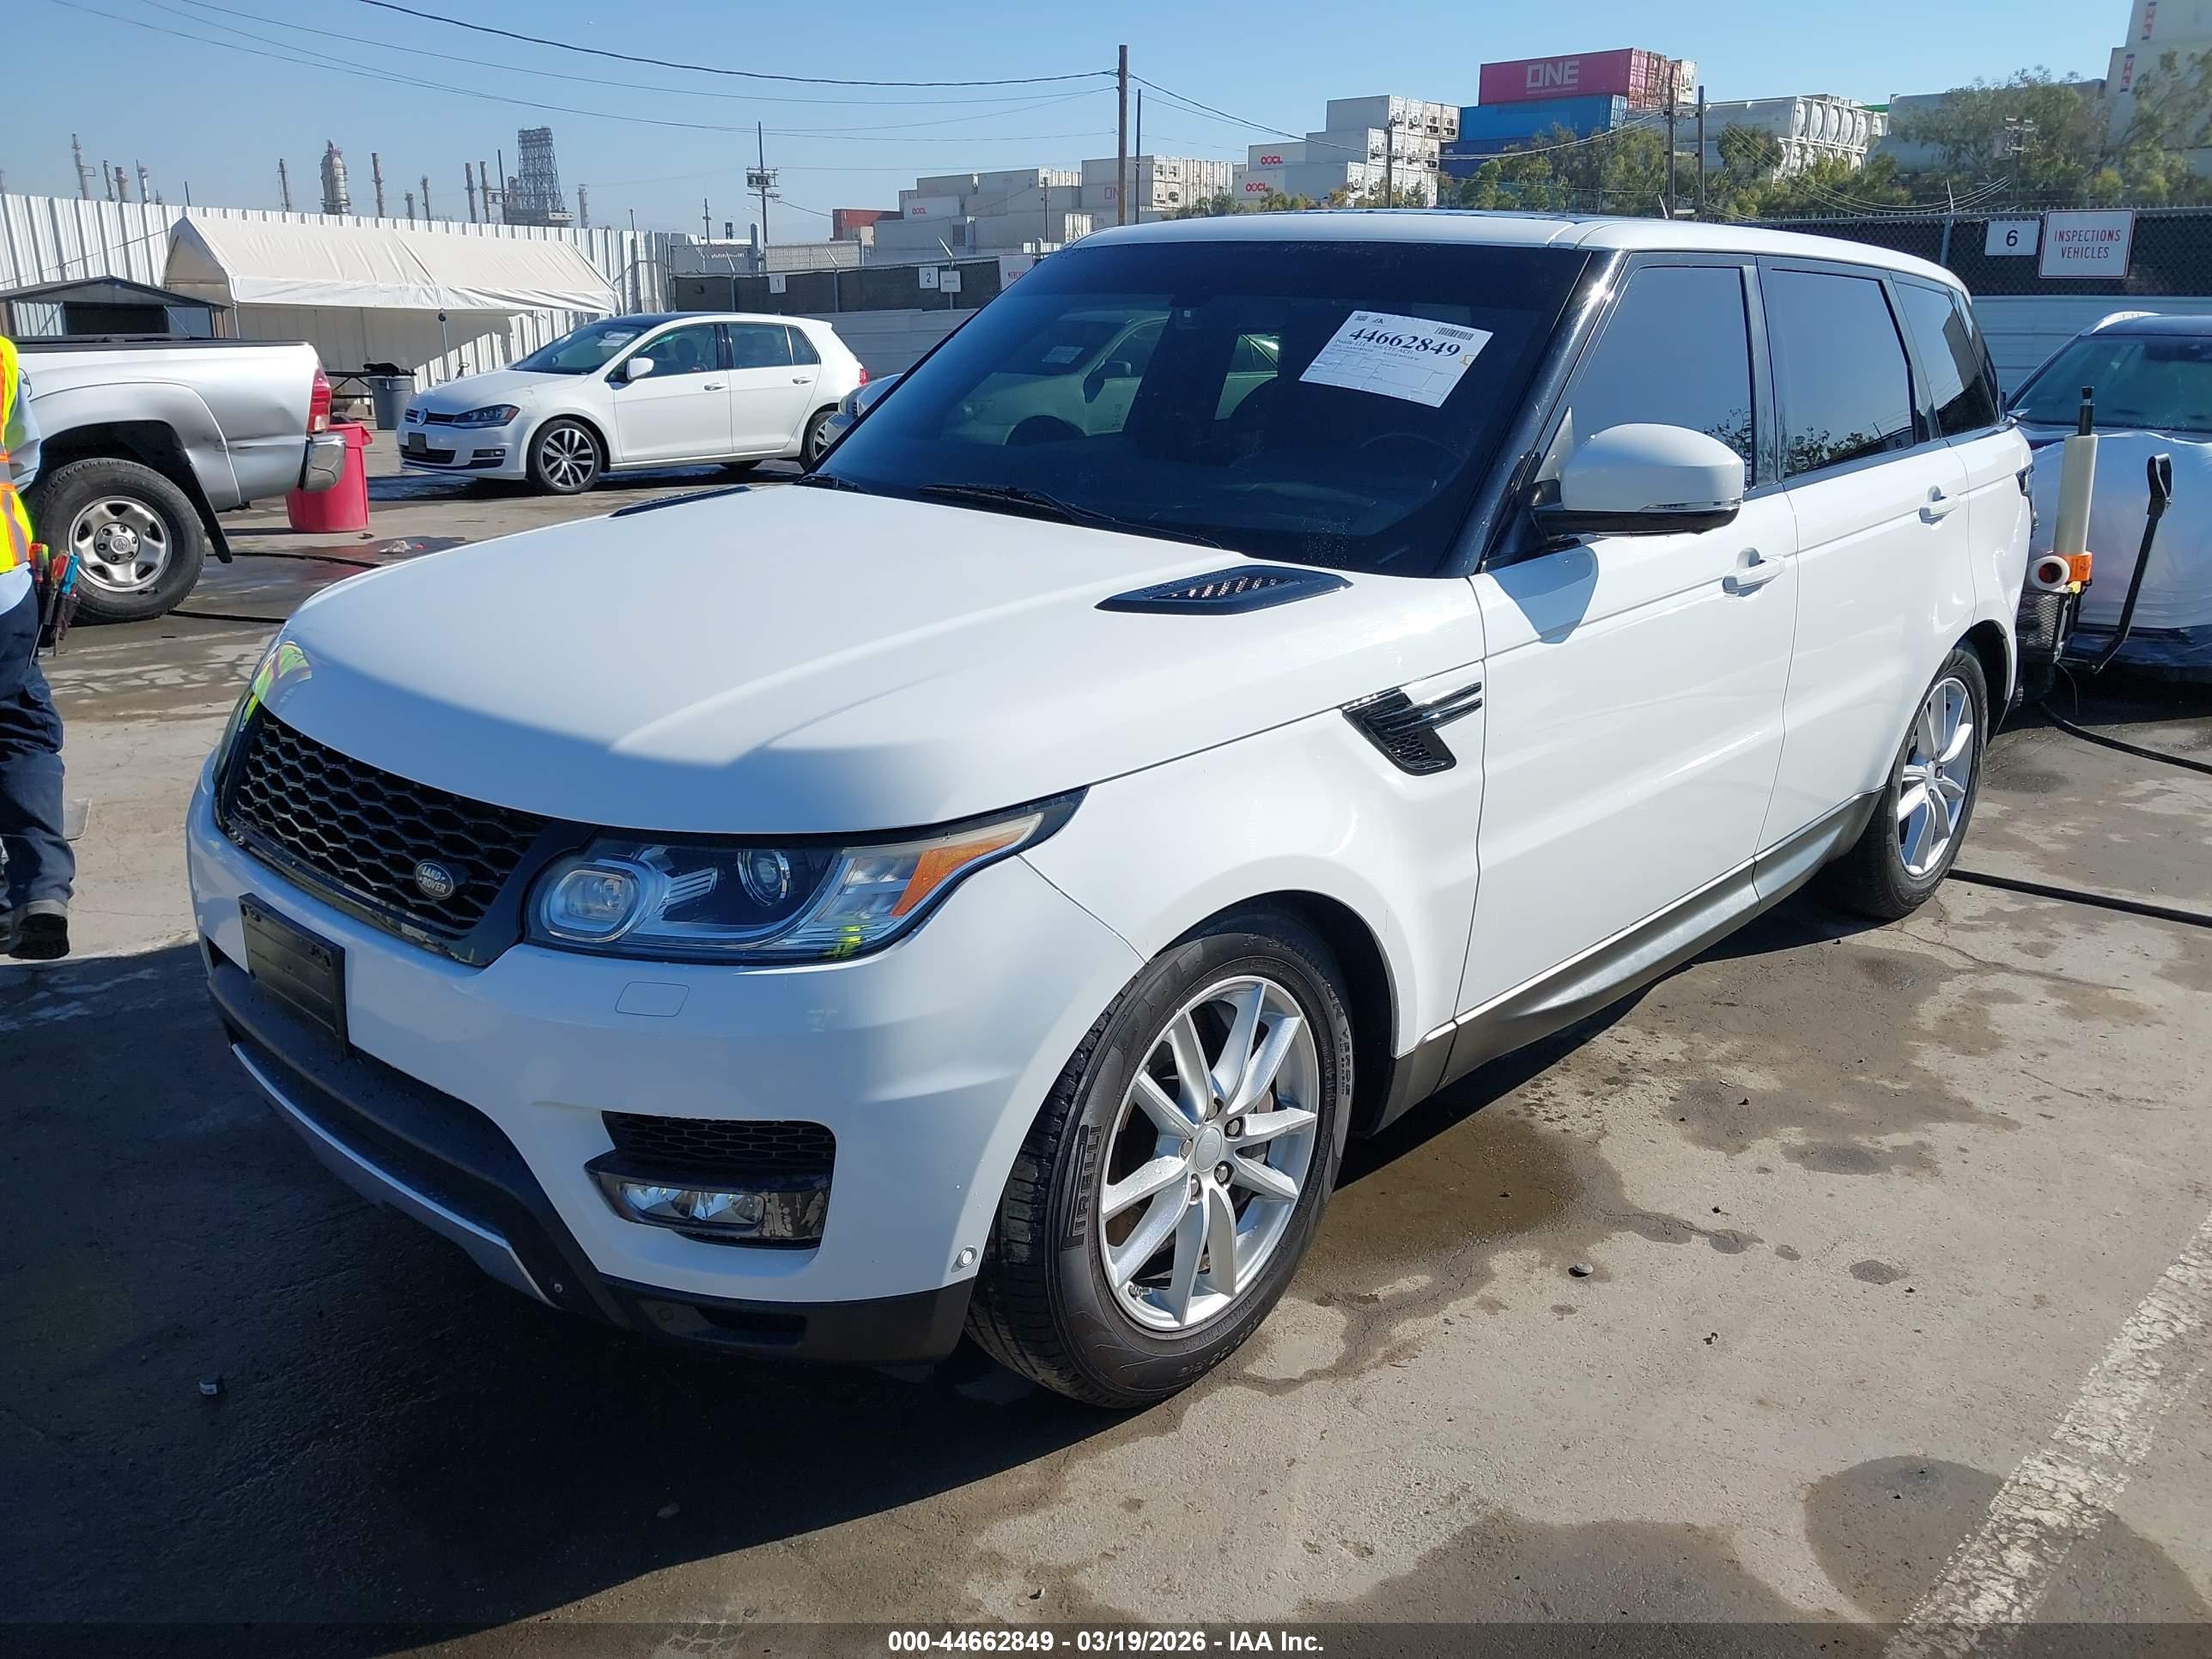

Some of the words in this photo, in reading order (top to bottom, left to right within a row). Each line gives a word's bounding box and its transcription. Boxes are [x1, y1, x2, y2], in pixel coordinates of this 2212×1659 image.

[1526, 61, 1579, 88] ONE
[1261, 155, 1283, 165] OOCL
[2006, 229, 2018, 246] 6
[2054, 229, 2121, 242] INSPECTIONS
[2061, 246, 2110, 259] VEHICLES
[776, 279, 781, 289] 1
[926, 272, 932, 283] 2
[1349, 328, 1462, 356] 44662849
[422, 866, 441, 880] LAND
[422, 878, 447, 893] ROVER
[1060, 1124, 1102, 1251] PIRELLI
